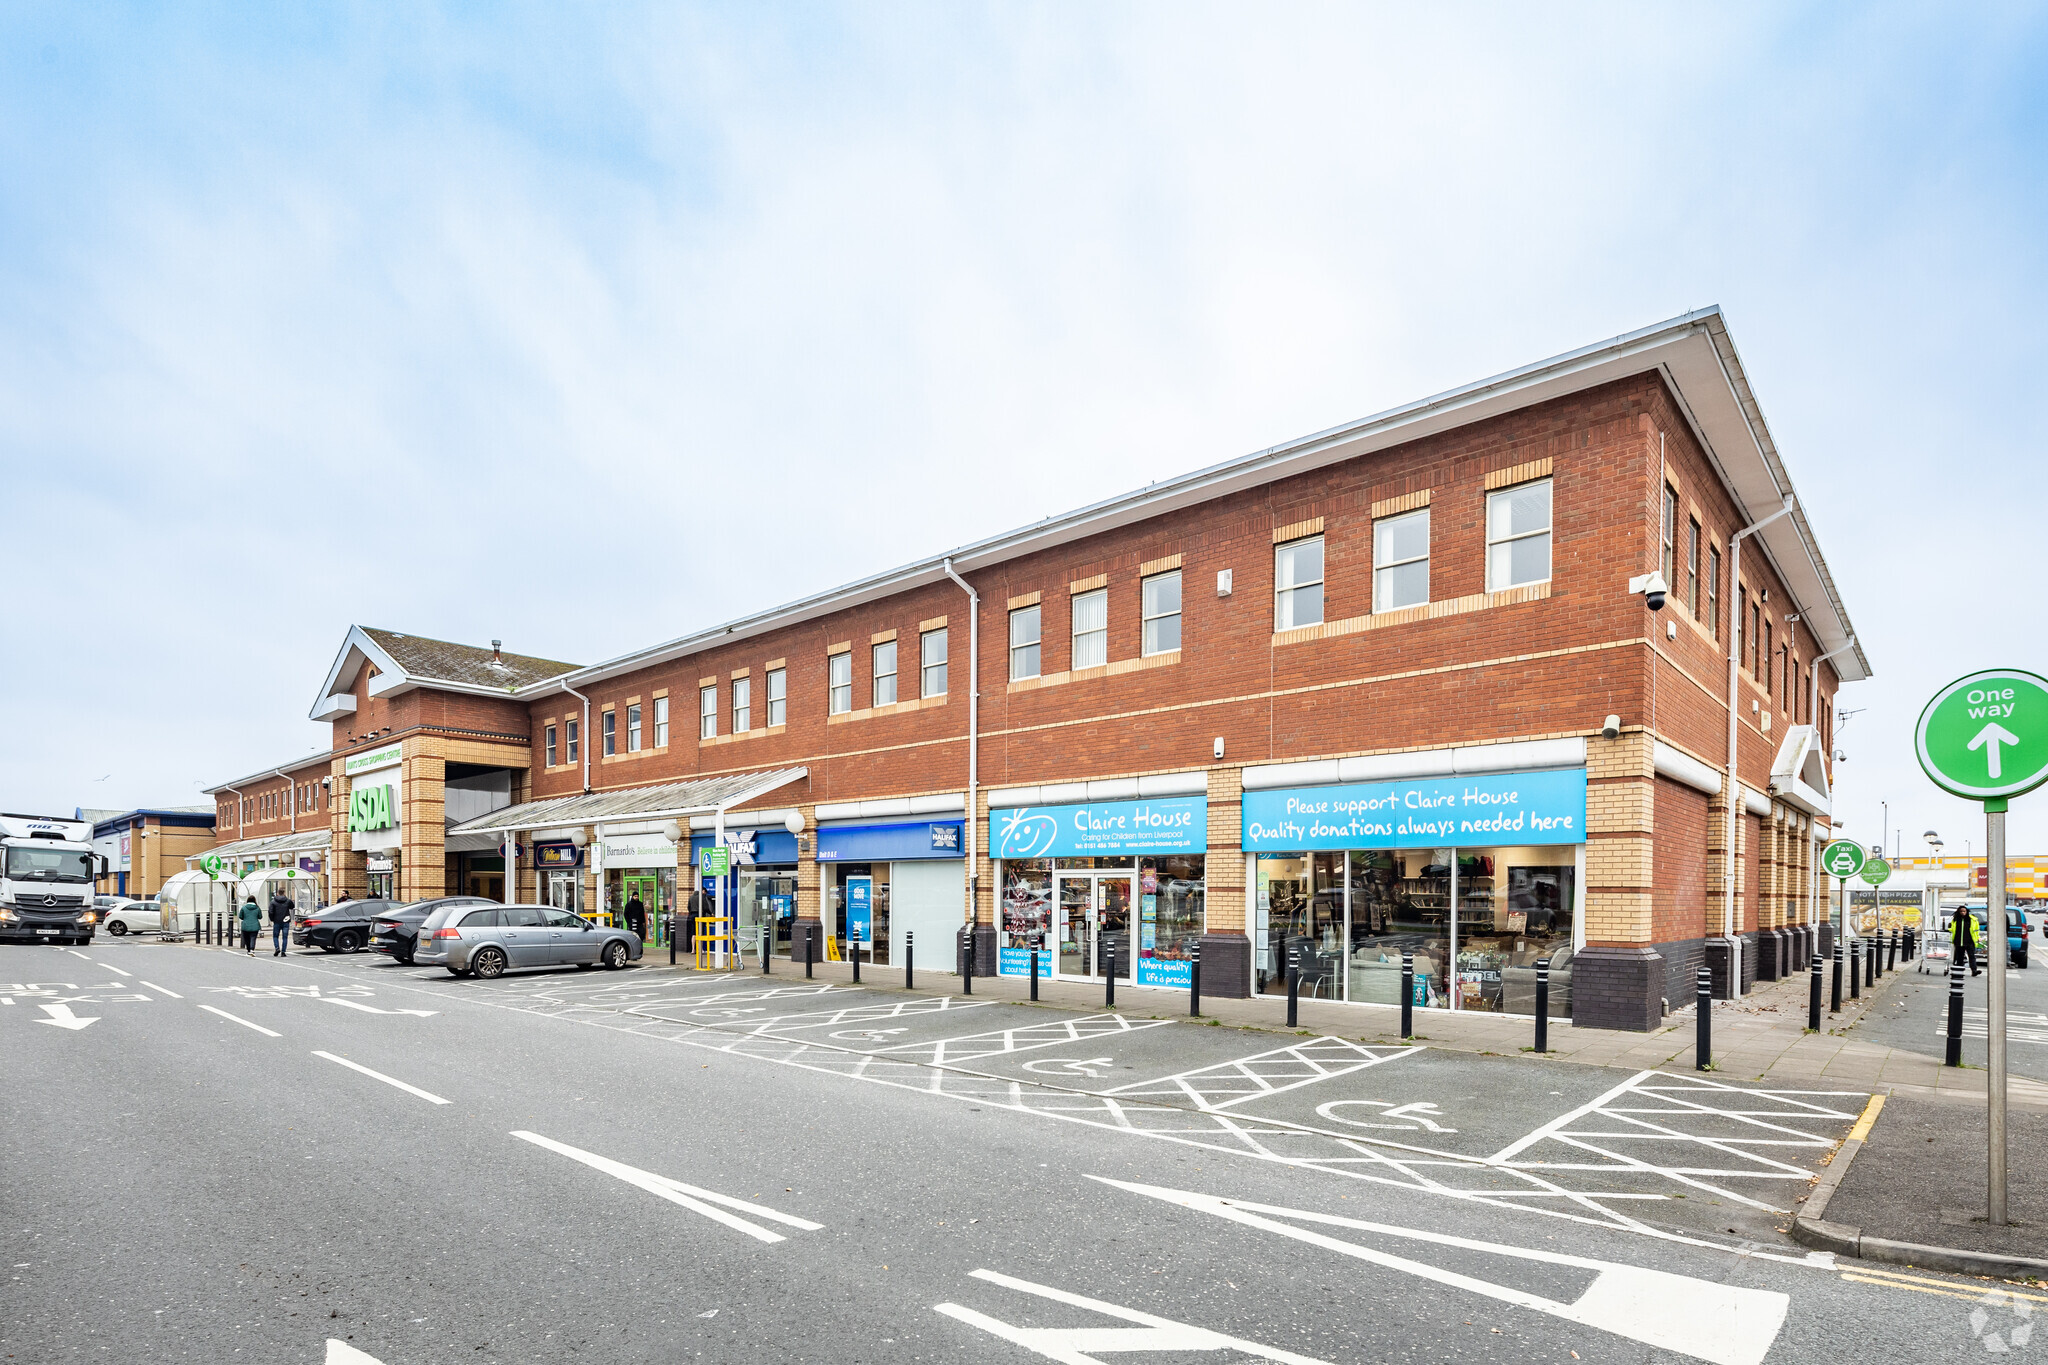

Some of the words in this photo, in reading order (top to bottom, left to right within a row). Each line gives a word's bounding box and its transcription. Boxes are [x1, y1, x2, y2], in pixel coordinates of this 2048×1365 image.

[1967, 688, 2014, 705] One
[1967, 702, 2016, 720] way
[347, 784, 393, 833] ASDA
[1286, 797, 1329, 816] Please
[1333, 792, 1400, 816] support
[1404, 790, 1456, 809] Claire
[1462, 787, 1519, 807] House
[1074, 810, 1126, 831] Claire
[1133, 806, 1192, 829] House
[1248, 819, 1307, 843] Quality
[1308, 818, 1393, 838] donations
[1397, 816, 1456, 838] always
[1460, 811, 1525, 832] needed
[1530, 810, 1574, 830] here
[932, 833, 957, 842] HALIFAX
[1081, 833, 1102, 842] Caring
[1102, 832, 1111, 841] for
[1111, 831, 1137, 840] Children
[1138, 831, 1153, 839] from
[1154, 830, 1183, 840] Liverpool
[560, 848, 572, 861] HILL
[1139, 960, 1163, 970] Where
[1164, 961, 1190, 974] quality
[1146, 972, 1159, 982] life
[1159, 973, 1165, 983] is
[1166, 974, 1191, 985] preciou
[235, 990, 376, 999] CAR
